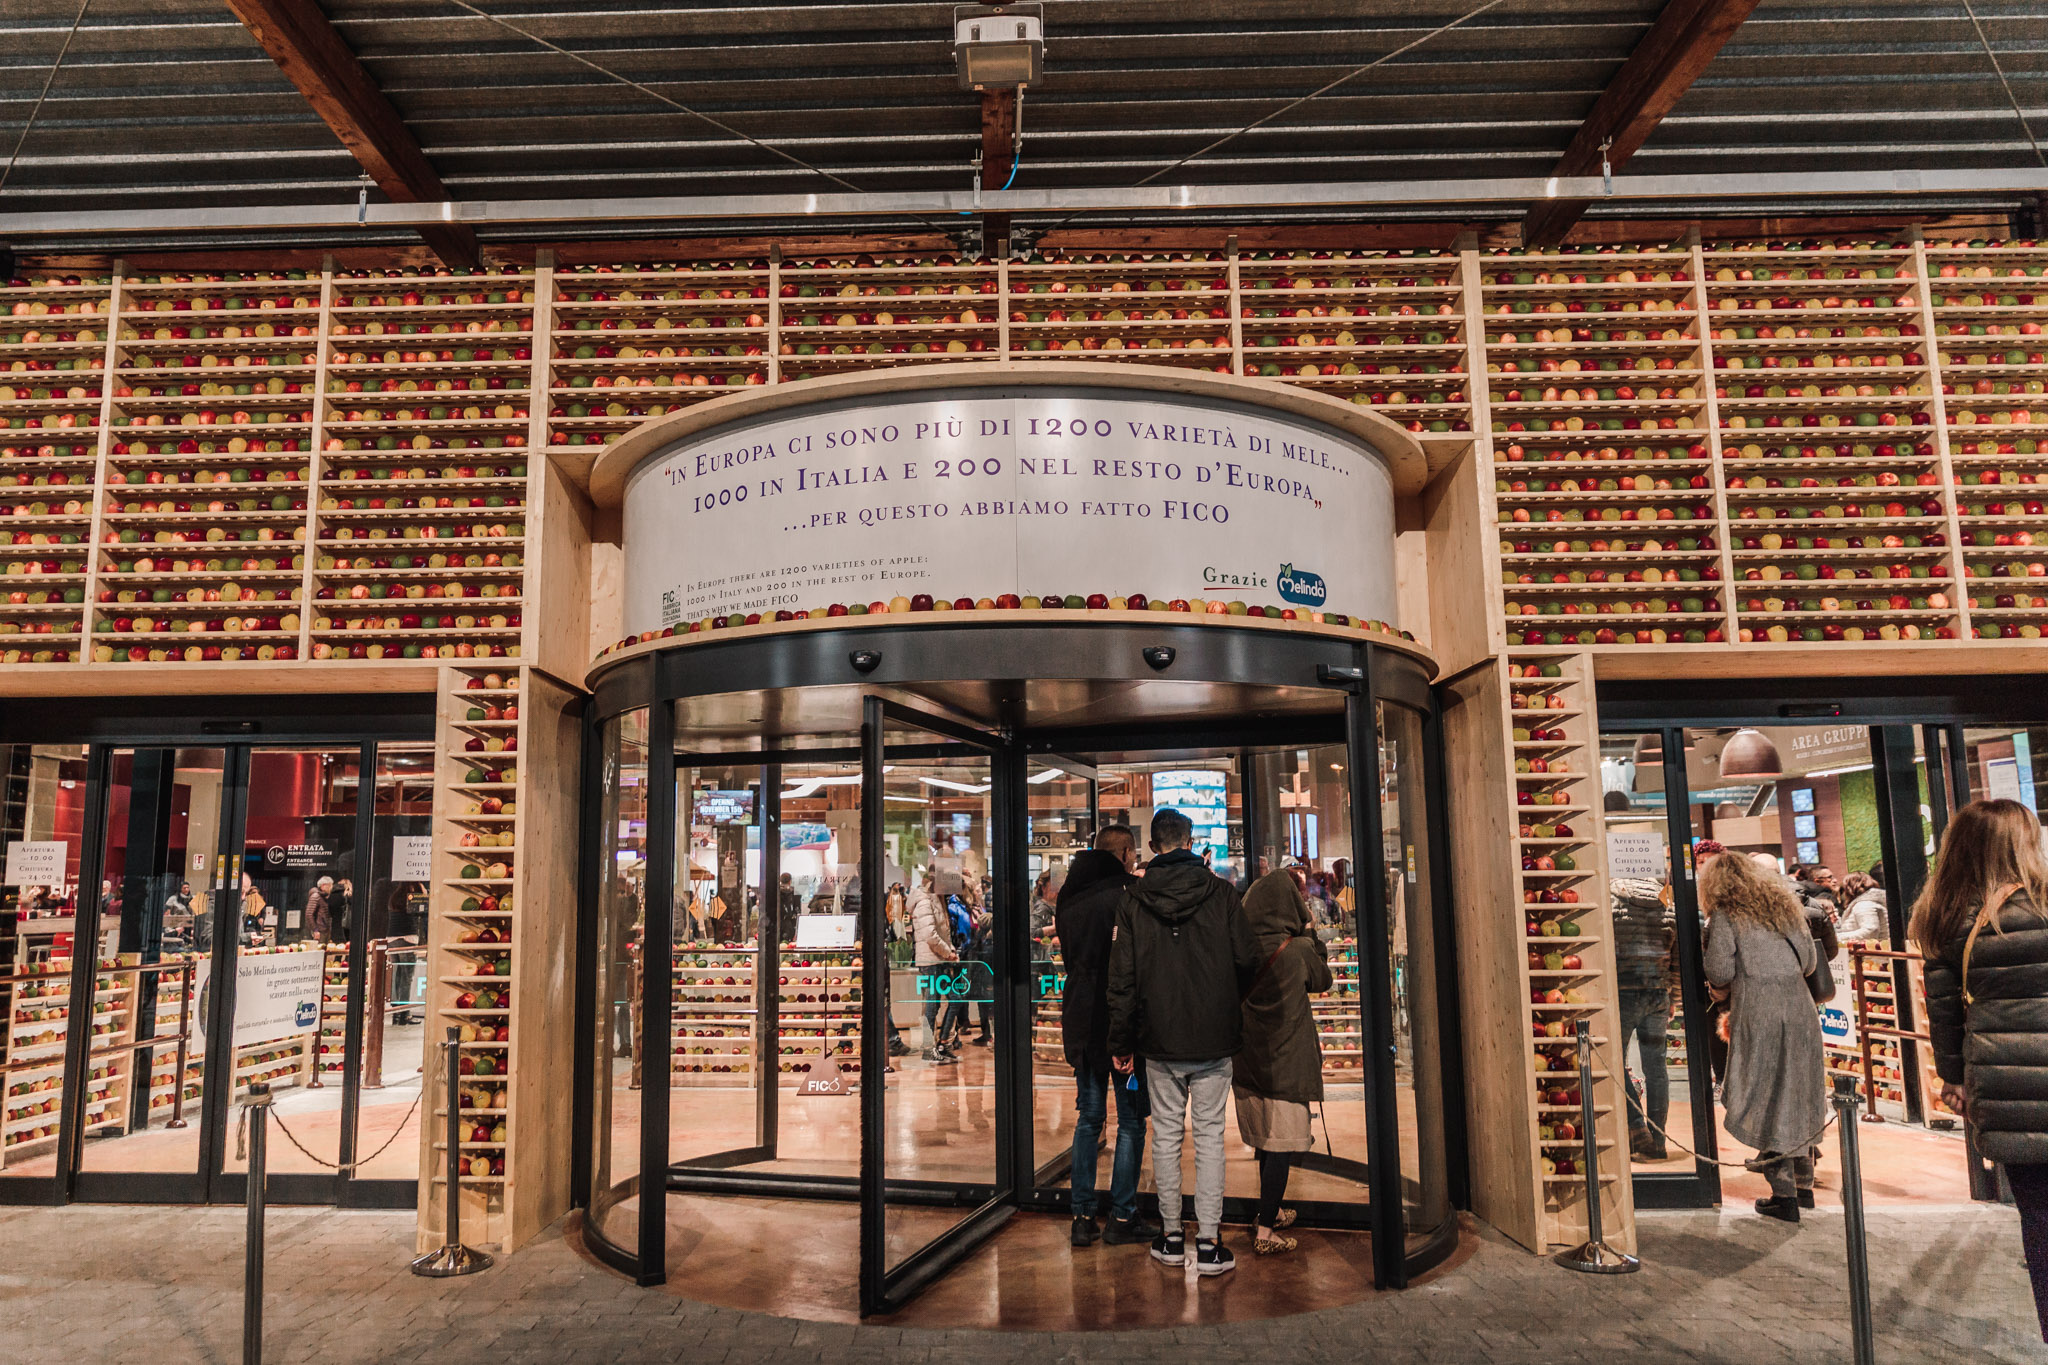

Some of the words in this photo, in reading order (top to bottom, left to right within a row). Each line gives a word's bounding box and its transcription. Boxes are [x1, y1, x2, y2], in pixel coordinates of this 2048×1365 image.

[788, 436, 813, 454] CI
[826, 425, 899, 449] SONO
[914, 415, 963, 440] PIÙ
[980, 418, 1010, 436] DI
[1027, 417, 1112, 438] 1200
[1127, 421, 1238, 449] VARIETÀ
[1249, 434, 1271, 455] DI
[693, 485, 748, 514] 1000
[760, 477, 784, 498] IN
[797, 464, 890, 492] ITALIA
[902, 462, 918, 480] E
[934, 457, 1001, 479] 200
[1019, 458, 1077, 476] NEL
[1093, 459, 1182, 481] RESTO
[858, 503, 949, 527] QUESTO
[960, 500, 1069, 517] ABBIAMO
[1081, 501, 1151, 518] FATTO
[1163, 500, 1230, 524] FICO
[730, 572, 756, 583] THERE
[760, 569, 777, 578] ARE
[780, 565, 808, 576] 1200
[812, 559, 866, 571] VARIETIES
[870, 558, 885, 566] OF
[1203, 566, 1268, 588] Grazie
[687, 595, 706, 606] 1000
[708, 592, 716, 601] IN
[745, 584, 762, 594] AND
[766, 582, 787, 591] 200
[791, 579, 802, 588] IN
[807, 578, 826, 587] THE
[831, 575, 857, 584] REST
[861, 573, 875, 581] OF
[711, 605, 728, 616] WHY
[730, 602, 741, 611] WE
[743, 599, 768, 610] MADE
[771, 593, 799, 605] FICO
[1791, 733, 1821, 751] AREA
[1823, 725, 1868, 745] GRUPPI
[1625, 866, 1652, 874] 24.00
[253, 964, 277, 976] Melinda
